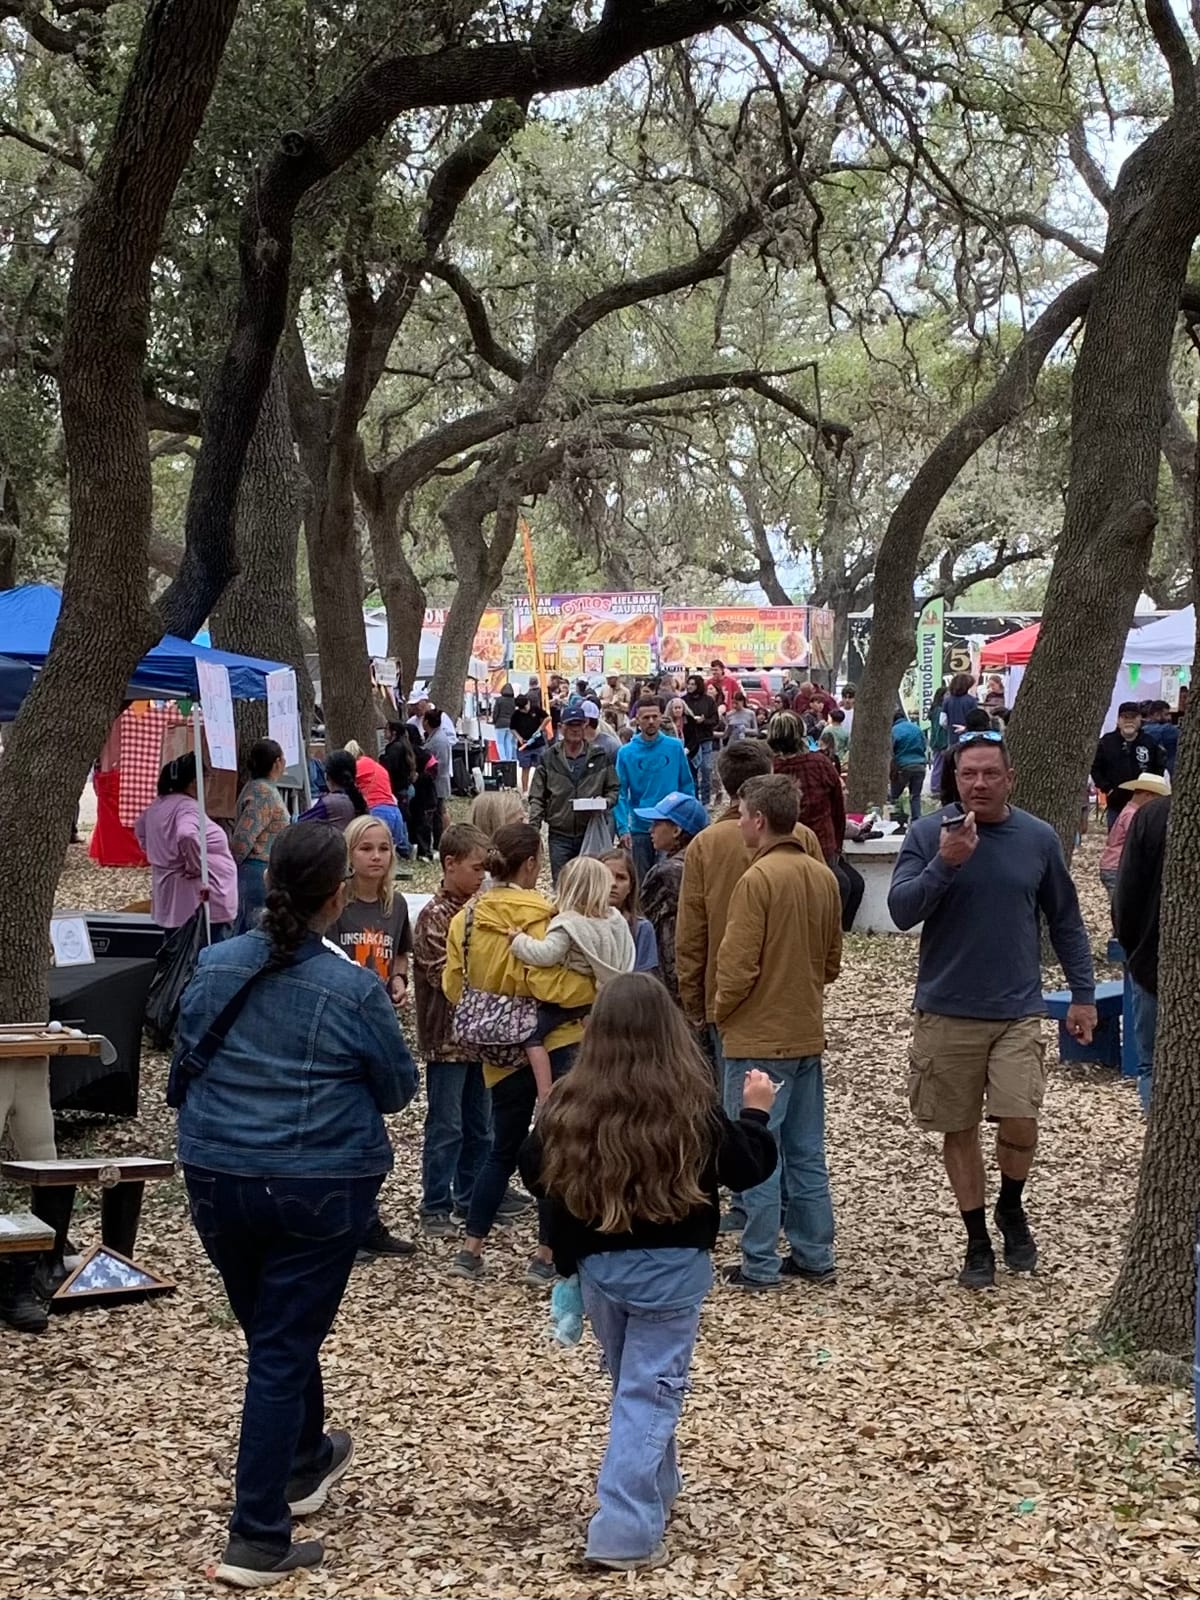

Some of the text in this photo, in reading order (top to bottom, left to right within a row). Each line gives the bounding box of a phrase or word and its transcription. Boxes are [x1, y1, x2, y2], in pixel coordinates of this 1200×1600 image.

[612, 595, 657, 605] KIELBASA
[561, 597, 611, 614] GYROS
[612, 605, 654, 614] SAUSAGE
[520, 607, 560, 615] SASAGE
